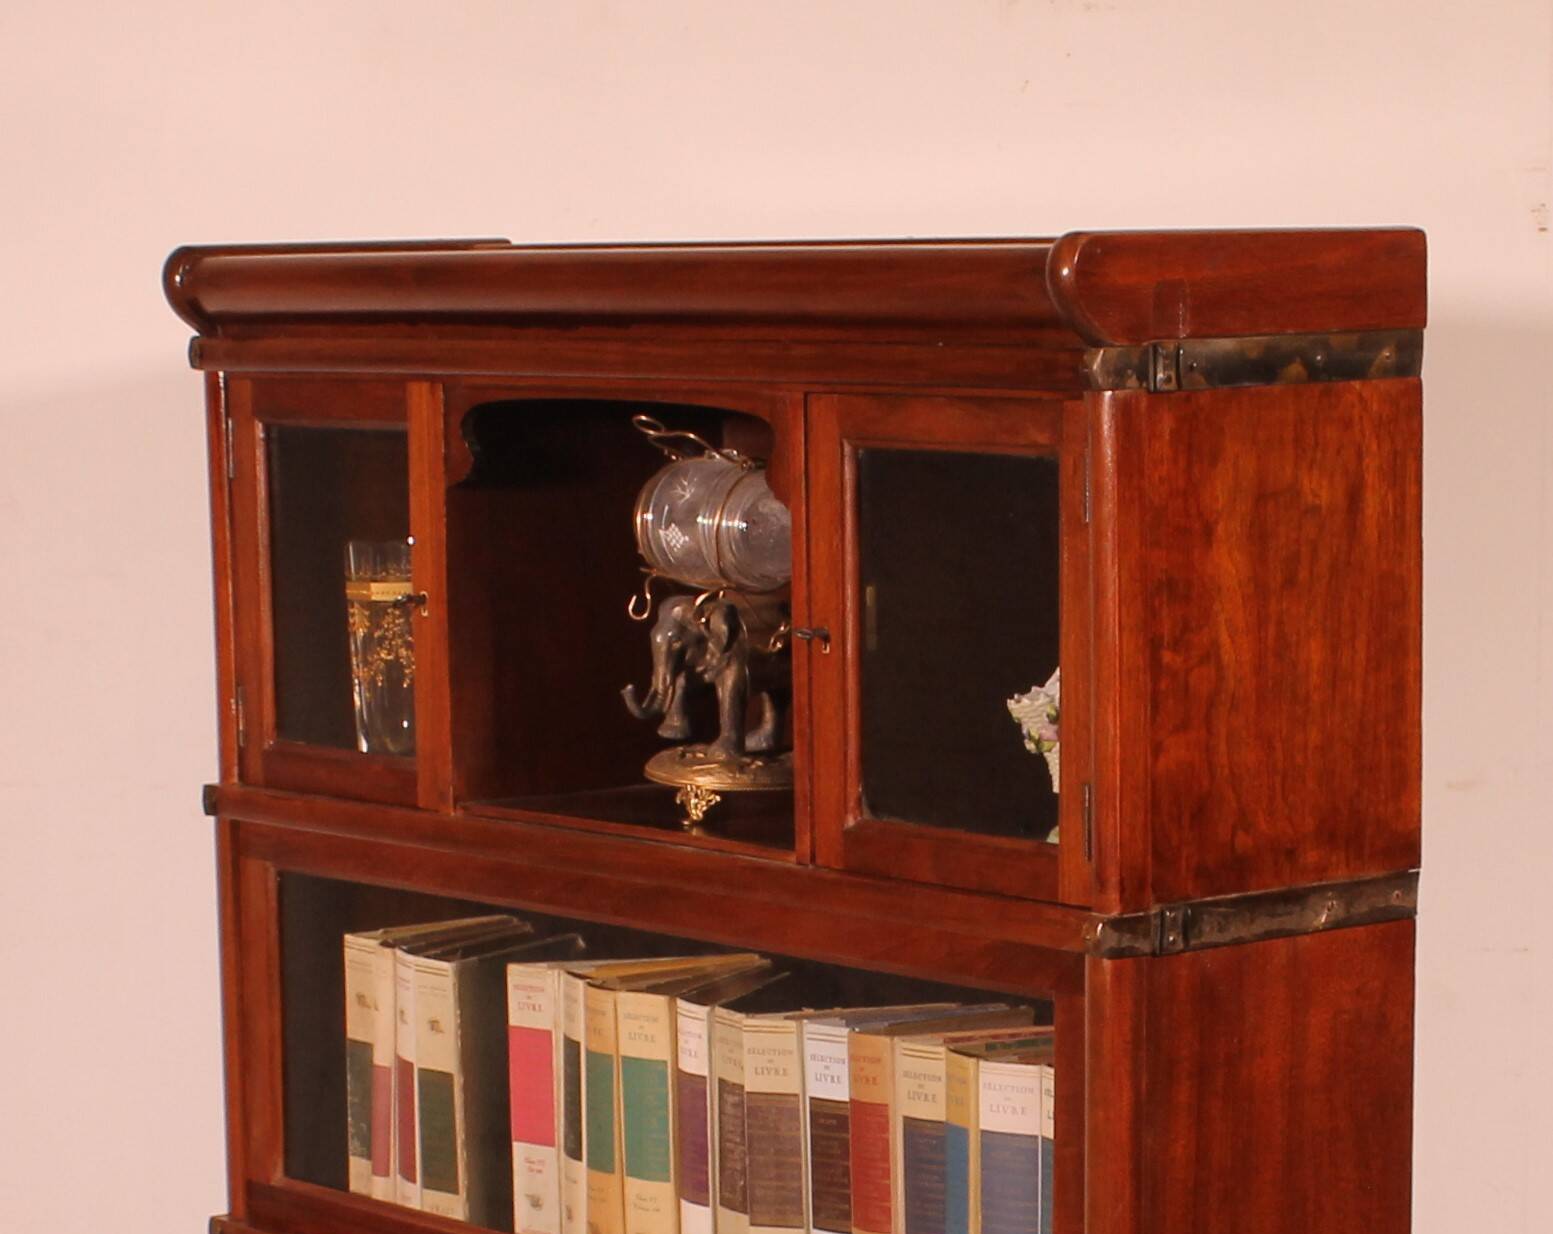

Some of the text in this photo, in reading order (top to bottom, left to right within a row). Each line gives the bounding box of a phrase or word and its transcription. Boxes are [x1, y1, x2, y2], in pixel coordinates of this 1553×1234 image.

[754, 1066, 789, 1078] LIVRE
[814, 1072, 842, 1084] LIVRE
[907, 1090, 937, 1104] LIVRE
[989, 1103, 1027, 1116] LIVRE
